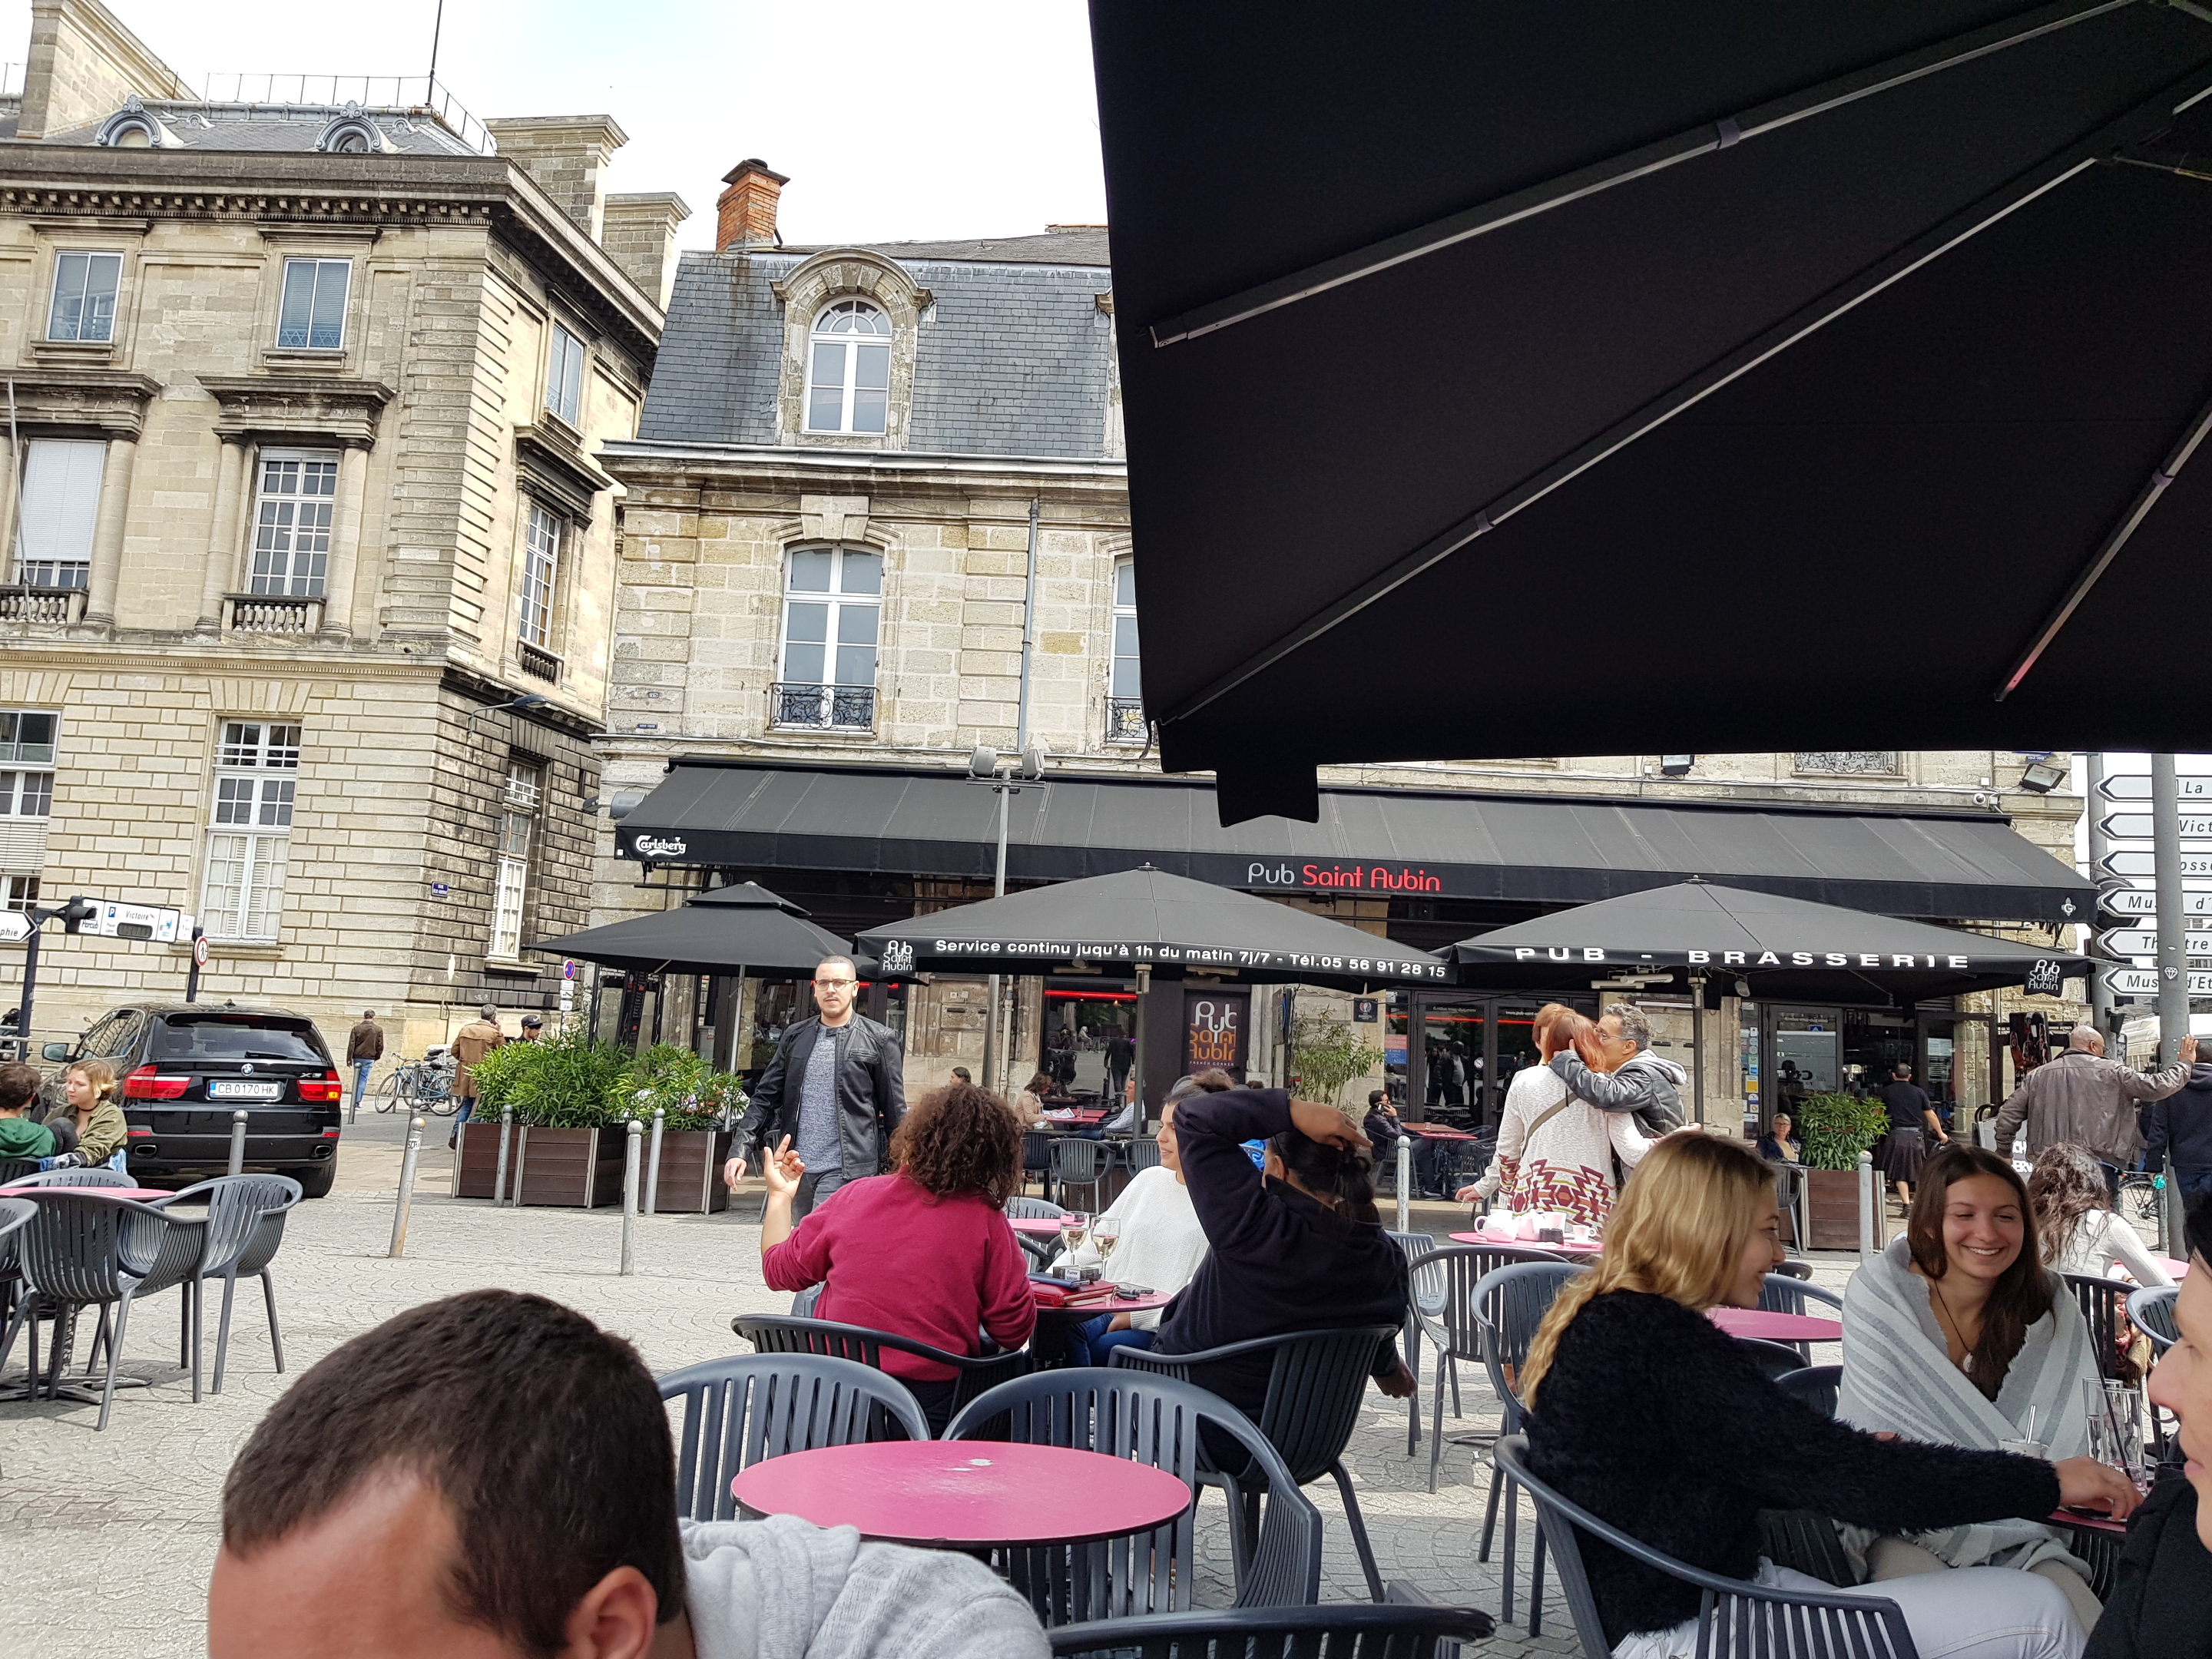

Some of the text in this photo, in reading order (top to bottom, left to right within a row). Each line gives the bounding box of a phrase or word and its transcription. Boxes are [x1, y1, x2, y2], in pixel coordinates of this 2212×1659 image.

[2185, 781, 2203, 793] La
[636, 835, 687, 855] Carlsberg
[1248, 863, 1441, 892] Pub Saint Aubin
[125, 910, 149, 920] Victoire
[888, 940, 913, 957] Pub
[883, 952, 912, 964] Saint
[935, 940, 1001, 952] Service
[1007, 942, 1071, 954] continu
[1075, 942, 1129, 957] juqu'à
[1136, 945, 1153, 956] 1h
[1159, 945, 1180, 958] du
[1186, 949, 1233, 962] matin
[1239, 951, 1270, 965] 7j/7
[1349, 959, 1369, 970] 56
[1376, 961, 1394, 972] 91
[1401, 962, 1422, 975] 28
[1429, 965, 1445, 977] 15
[1515, 947, 1605, 961] PUB
[1688, 950, 1968, 969] BRASSERIE
[883, 961, 912, 971] Aubin
[2035, 959, 2060, 976] Pub
[2029, 970, 2059, 983] Saint
[2028, 979, 2058, 991] Aubin
[1195, 1001, 1237, 1033] Pub
[218, 1084, 274, 1094] CB 0170 HK
